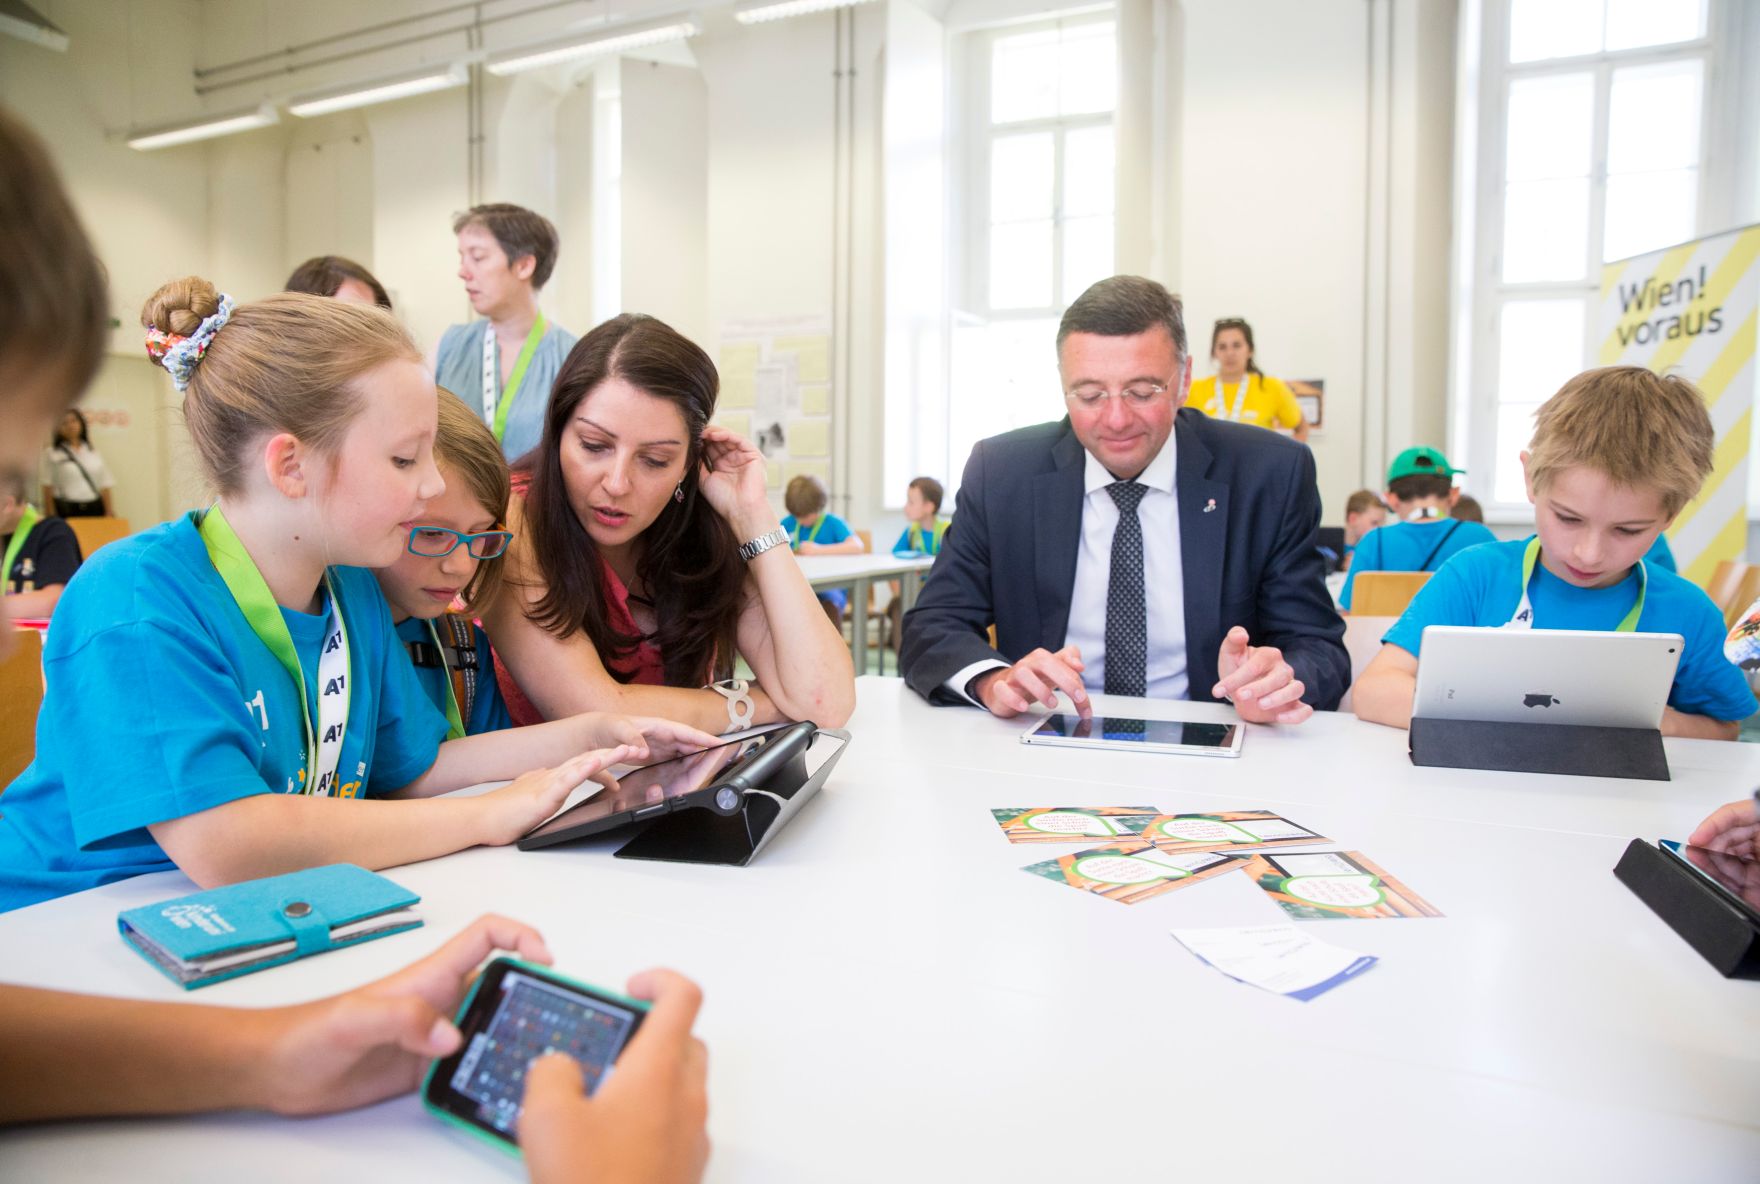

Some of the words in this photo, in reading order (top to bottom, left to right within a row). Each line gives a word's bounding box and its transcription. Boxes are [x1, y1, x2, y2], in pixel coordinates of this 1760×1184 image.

[1618, 265, 1706, 314] Wien!
[1616, 307, 1723, 347] voraus
[325, 630, 342, 654] A1
[323, 675, 345, 696] A1
[323, 723, 343, 743] A1
[317, 770, 333, 792] A1
